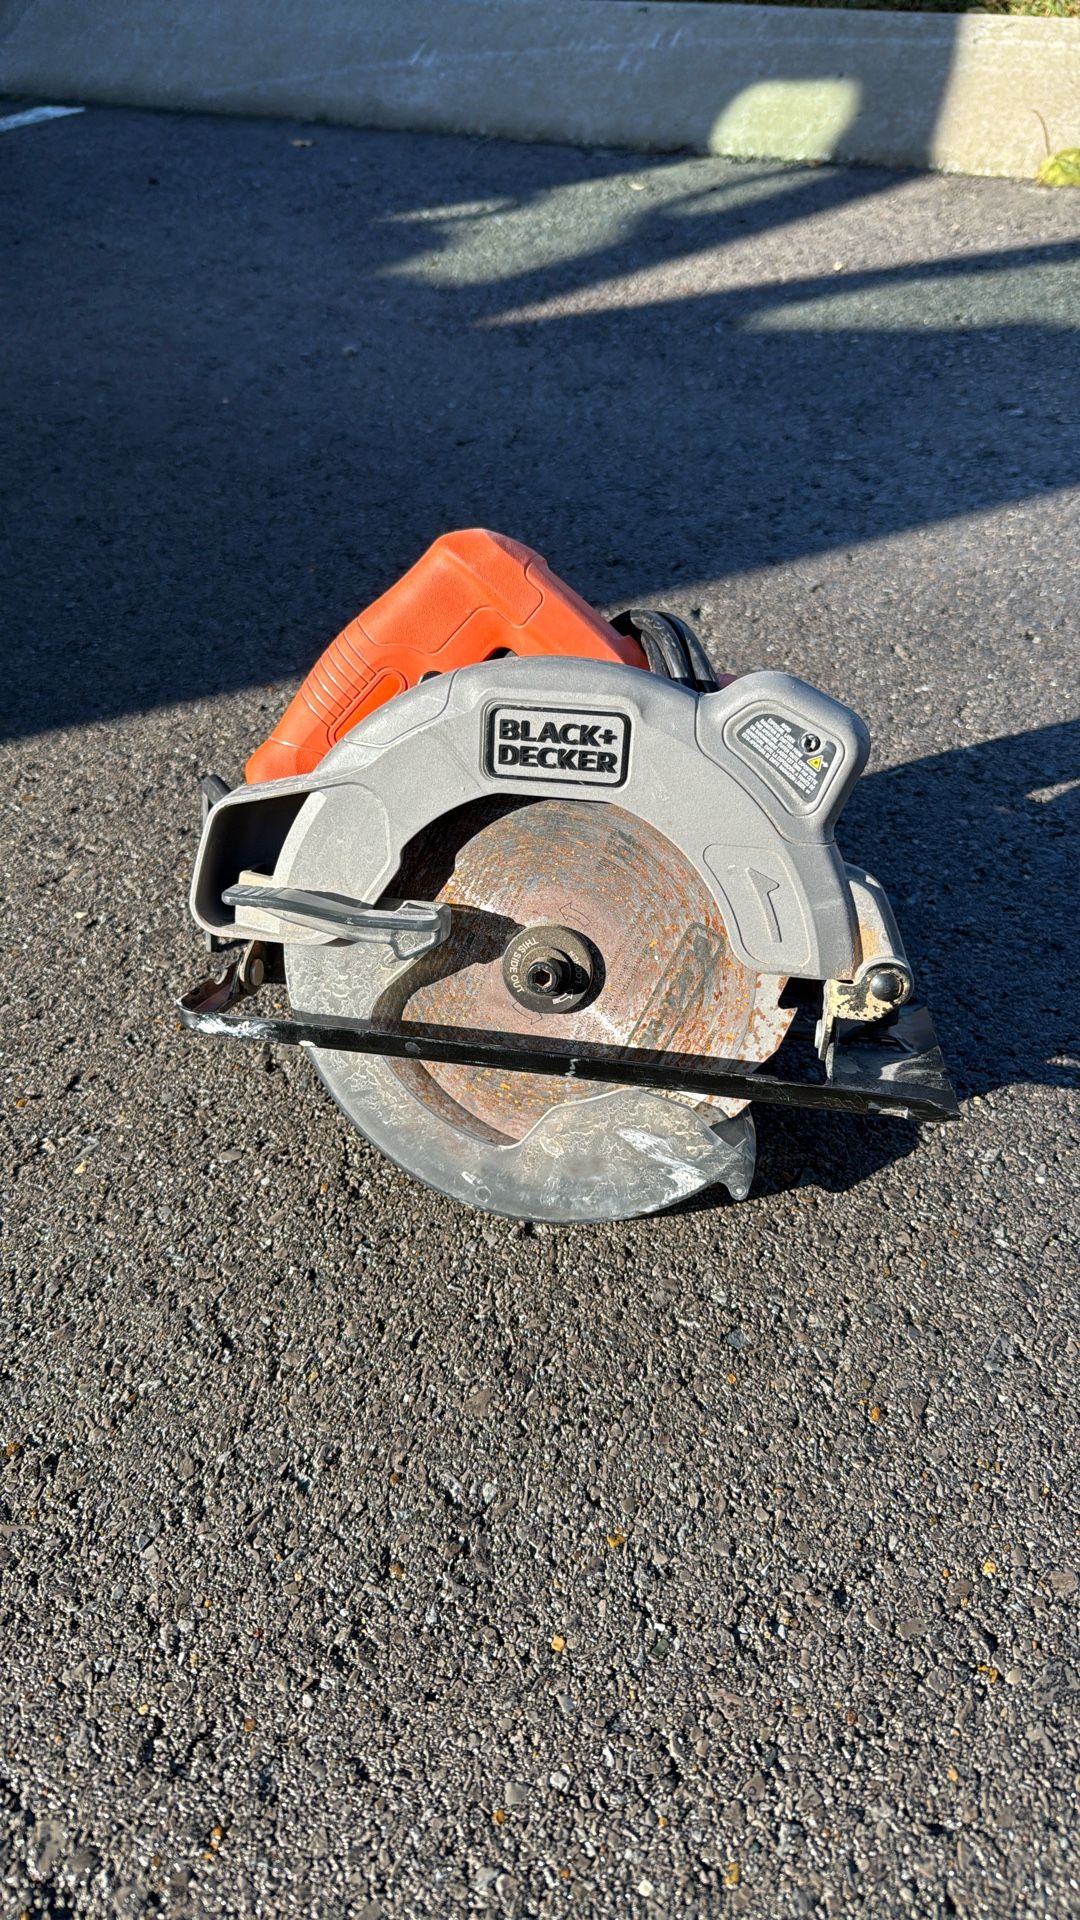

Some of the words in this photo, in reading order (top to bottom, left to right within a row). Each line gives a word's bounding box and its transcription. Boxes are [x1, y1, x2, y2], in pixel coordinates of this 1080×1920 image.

[499, 719, 618, 747] BLACK+
[498, 744, 618, 773] DECKER
[518, 937, 539, 953] THIS
[510, 951, 522, 973] SIDE
[510, 974, 525, 993] OUT
